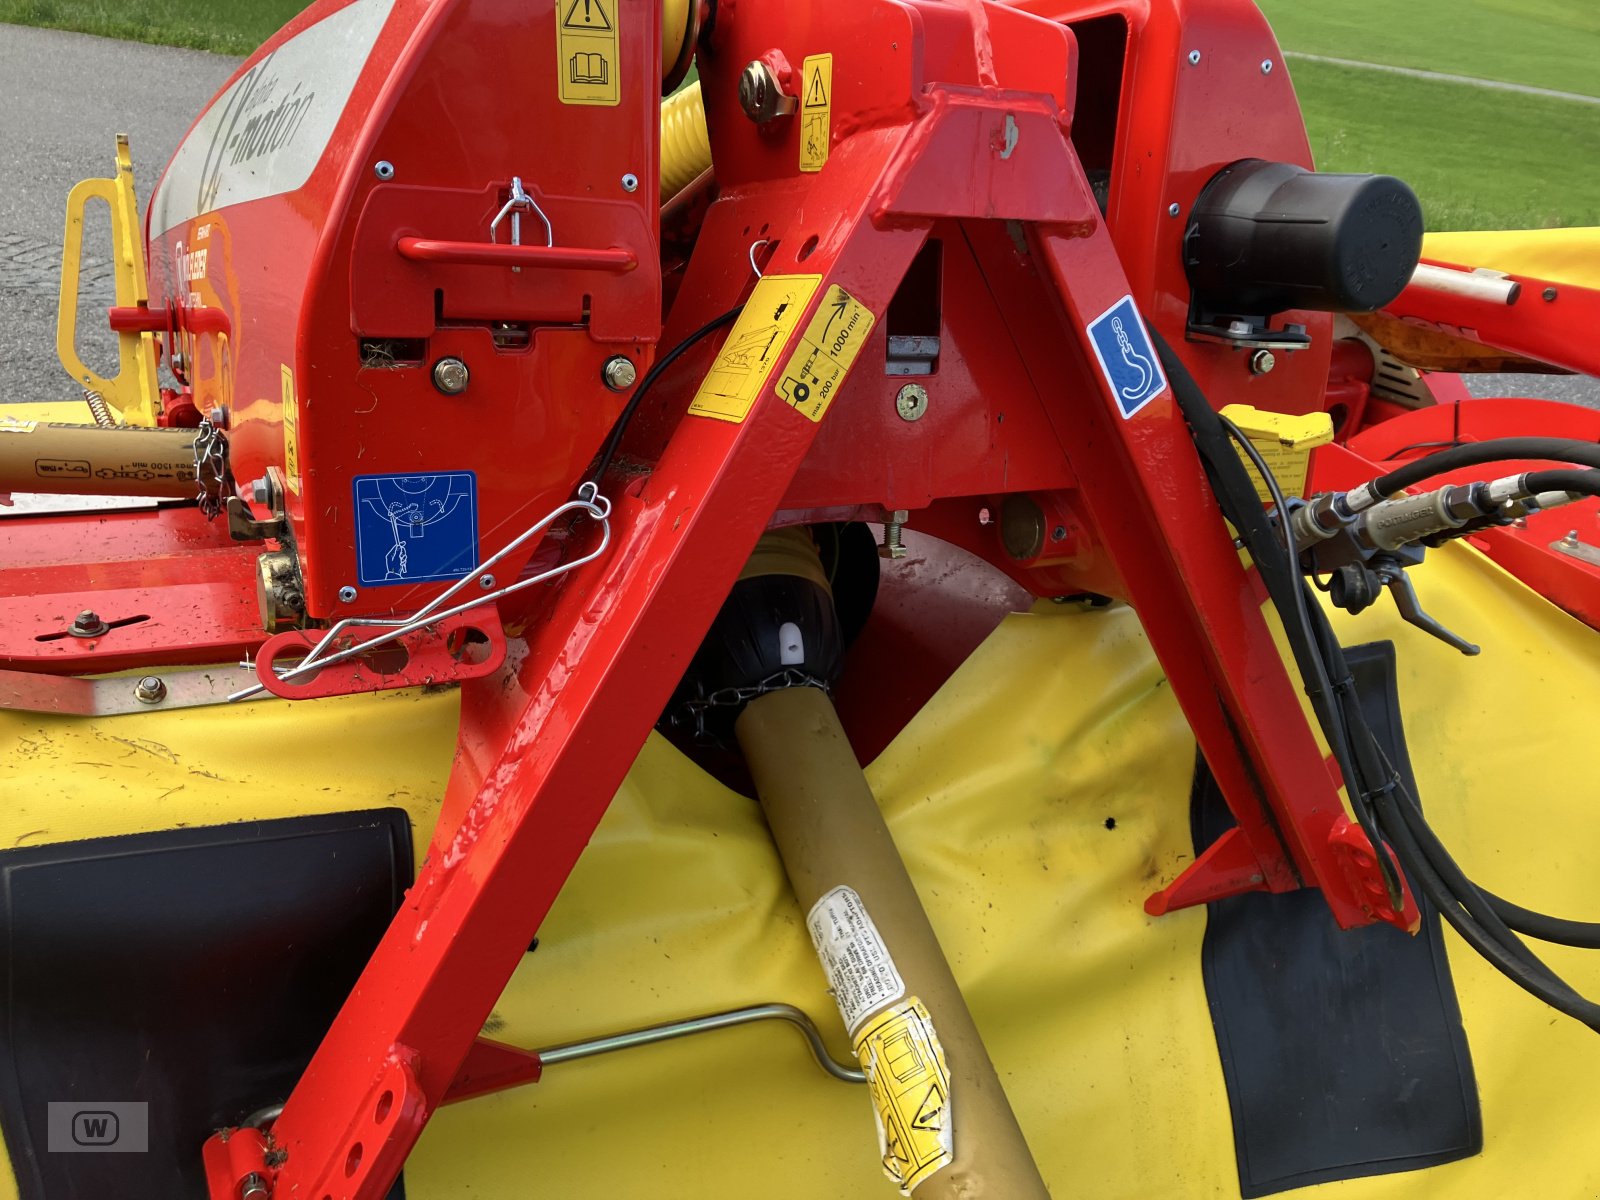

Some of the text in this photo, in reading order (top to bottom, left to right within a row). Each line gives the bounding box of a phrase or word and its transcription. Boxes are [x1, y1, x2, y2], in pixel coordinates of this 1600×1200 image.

[830, 329, 849, 358] 1000
[820, 380, 833, 400] 200
[831, 368, 840, 381] bar
